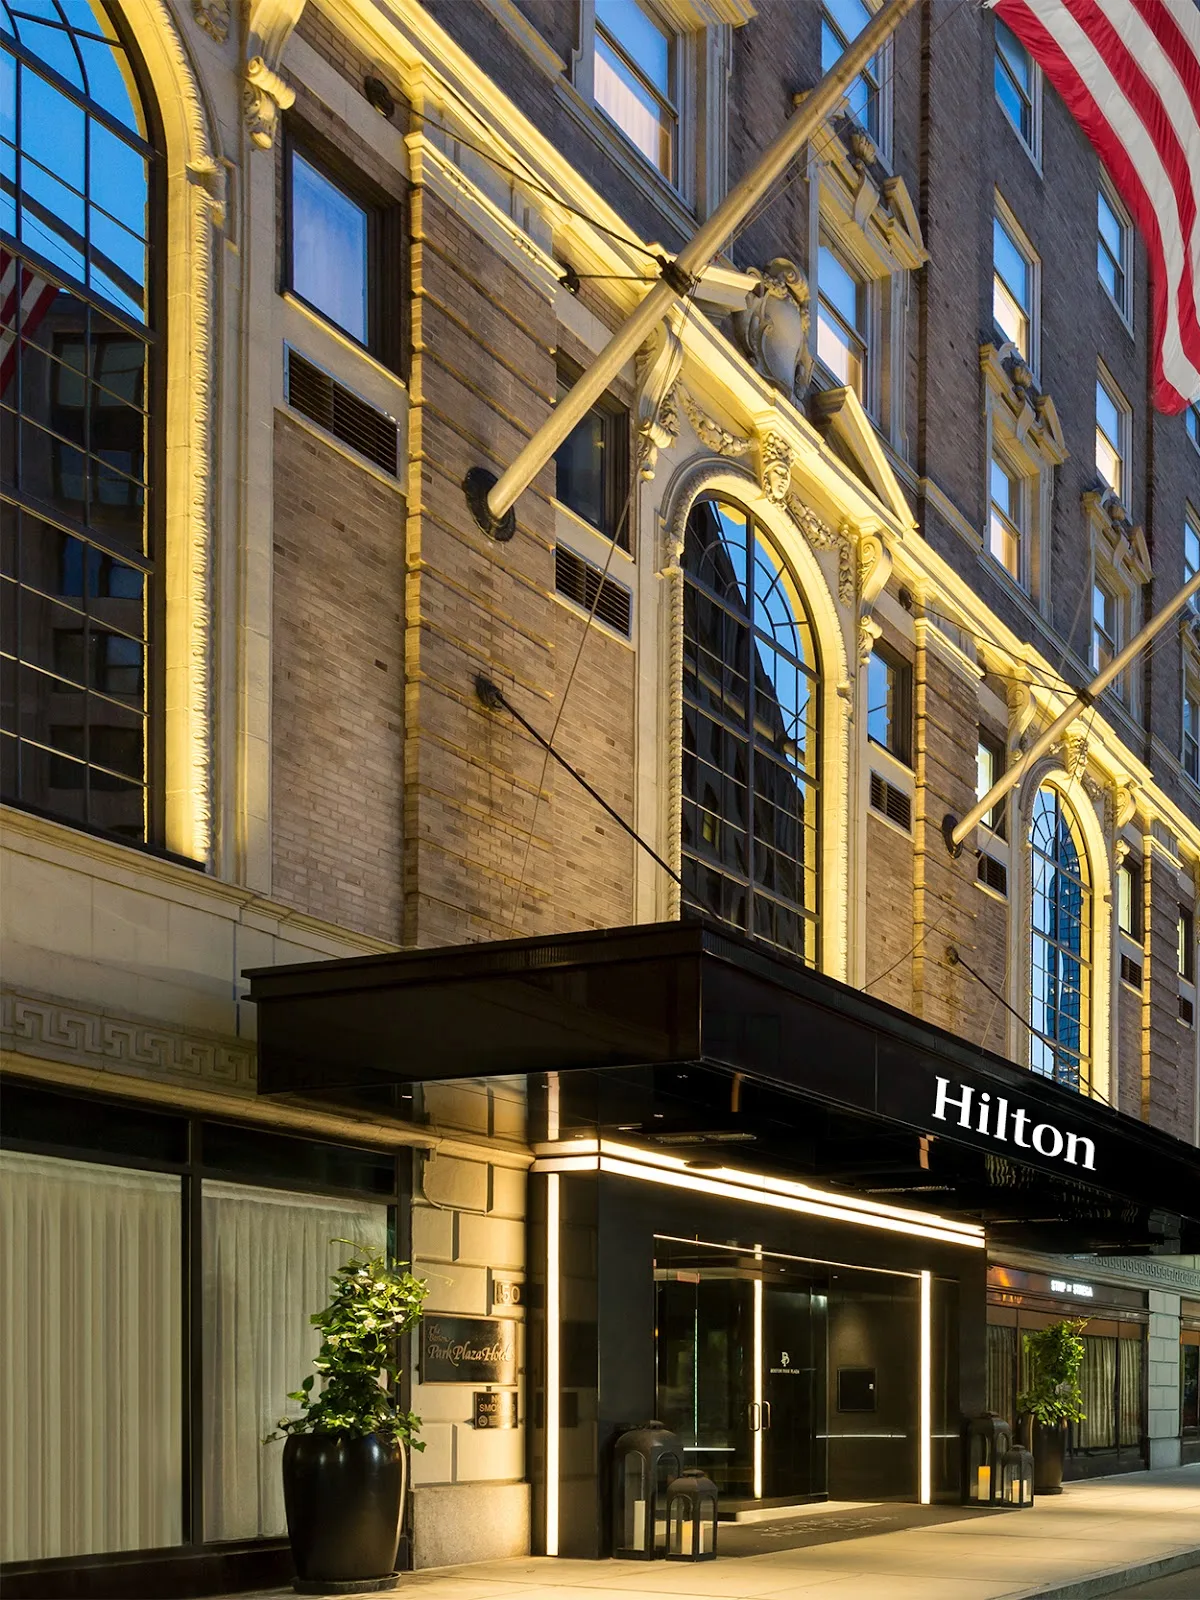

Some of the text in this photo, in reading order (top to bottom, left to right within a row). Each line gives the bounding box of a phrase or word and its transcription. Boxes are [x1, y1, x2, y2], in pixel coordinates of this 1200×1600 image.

[931, 1075, 1097, 1171] Hilton
[428, 1340, 512, 1367] Park Plaza Hotel
[479, 1403, 516, 1412] SMOKG
